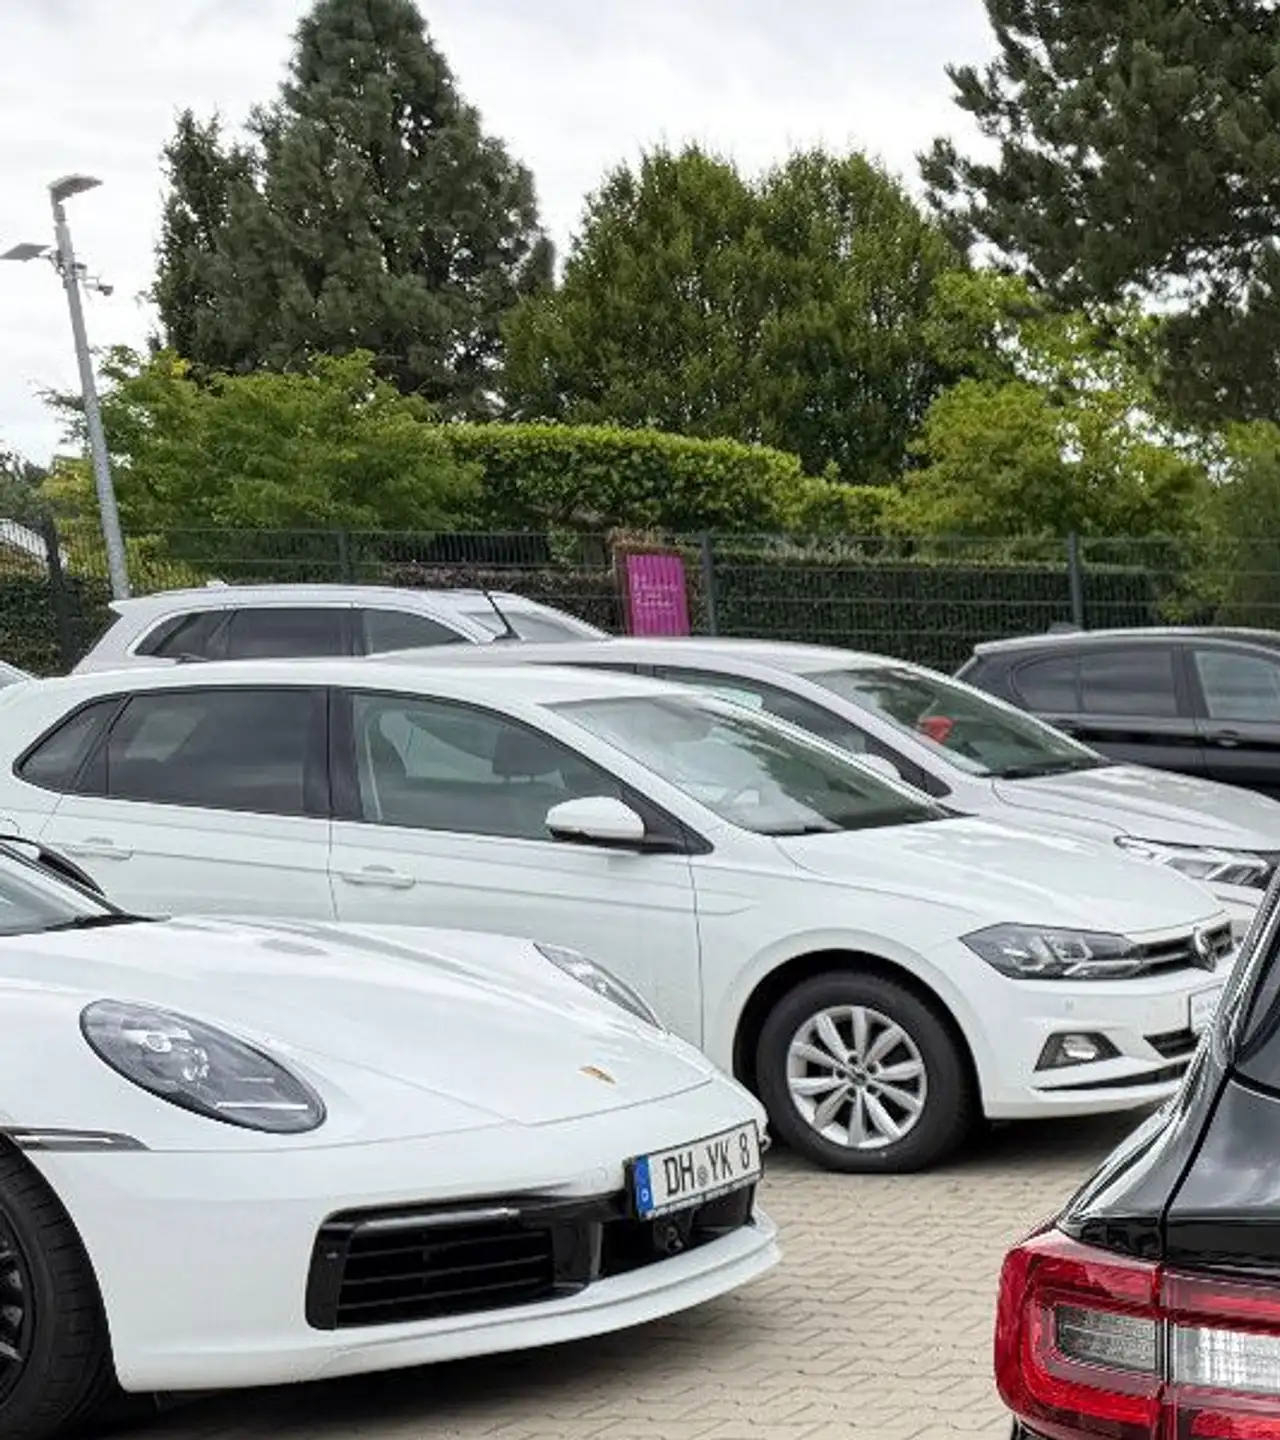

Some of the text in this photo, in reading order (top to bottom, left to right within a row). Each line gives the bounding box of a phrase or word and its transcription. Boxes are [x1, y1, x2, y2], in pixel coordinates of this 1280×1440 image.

[663, 1150, 695, 1197] DH
[705, 1139, 733, 1181] YK
[739, 1132, 750, 1170] 8
